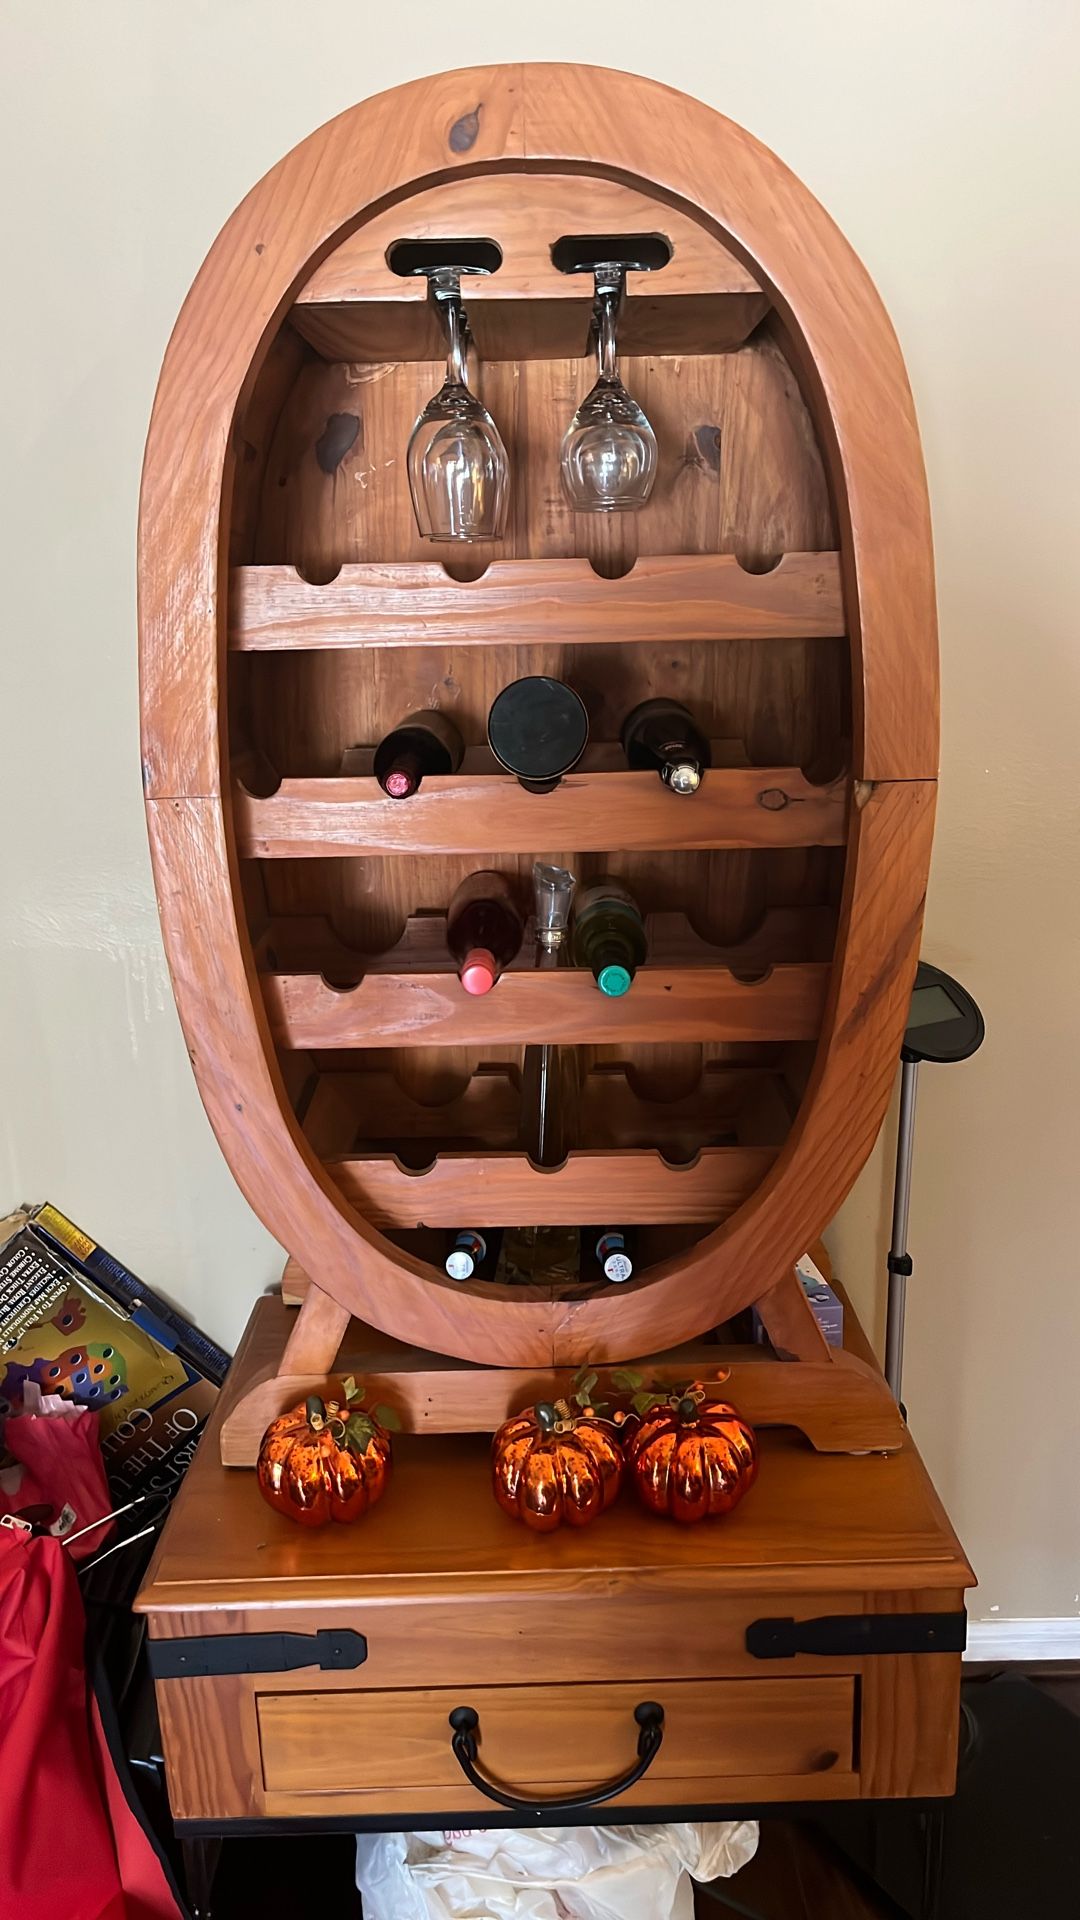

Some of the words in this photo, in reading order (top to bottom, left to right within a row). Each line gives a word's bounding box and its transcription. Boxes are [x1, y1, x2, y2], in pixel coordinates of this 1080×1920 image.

[6, 1249, 26, 1268] COLOR
[9, 1255, 33, 1278] CHROME
[21, 1260, 40, 1278] EXTRA
[23, 1266, 47, 1290] ELEGANT
[5, 1277, 26, 1295] THICK
[28, 1272, 54, 1297] INCLUDES
[45, 1278, 61, 1294] EACH
[49, 1284, 68, 1301] OPENS
[8, 1288, 27, 1305] ROYAL
[34, 1291, 49, 1305] MAP
[41, 1300, 53, 1310] TO
[1, 1296, 31, 1327] CERTIFICATE
[2, 1304, 37, 1337] INDIVIDUALLY
[24, 1313, 40, 1328] FULL
[35, 1308, 44, 1316] A
[102, 1408, 153, 1457] COLL
[164, 1408, 198, 1439] OF
[122, 1437, 174, 1476] THE
[165, 1435, 201, 1475] IRST
